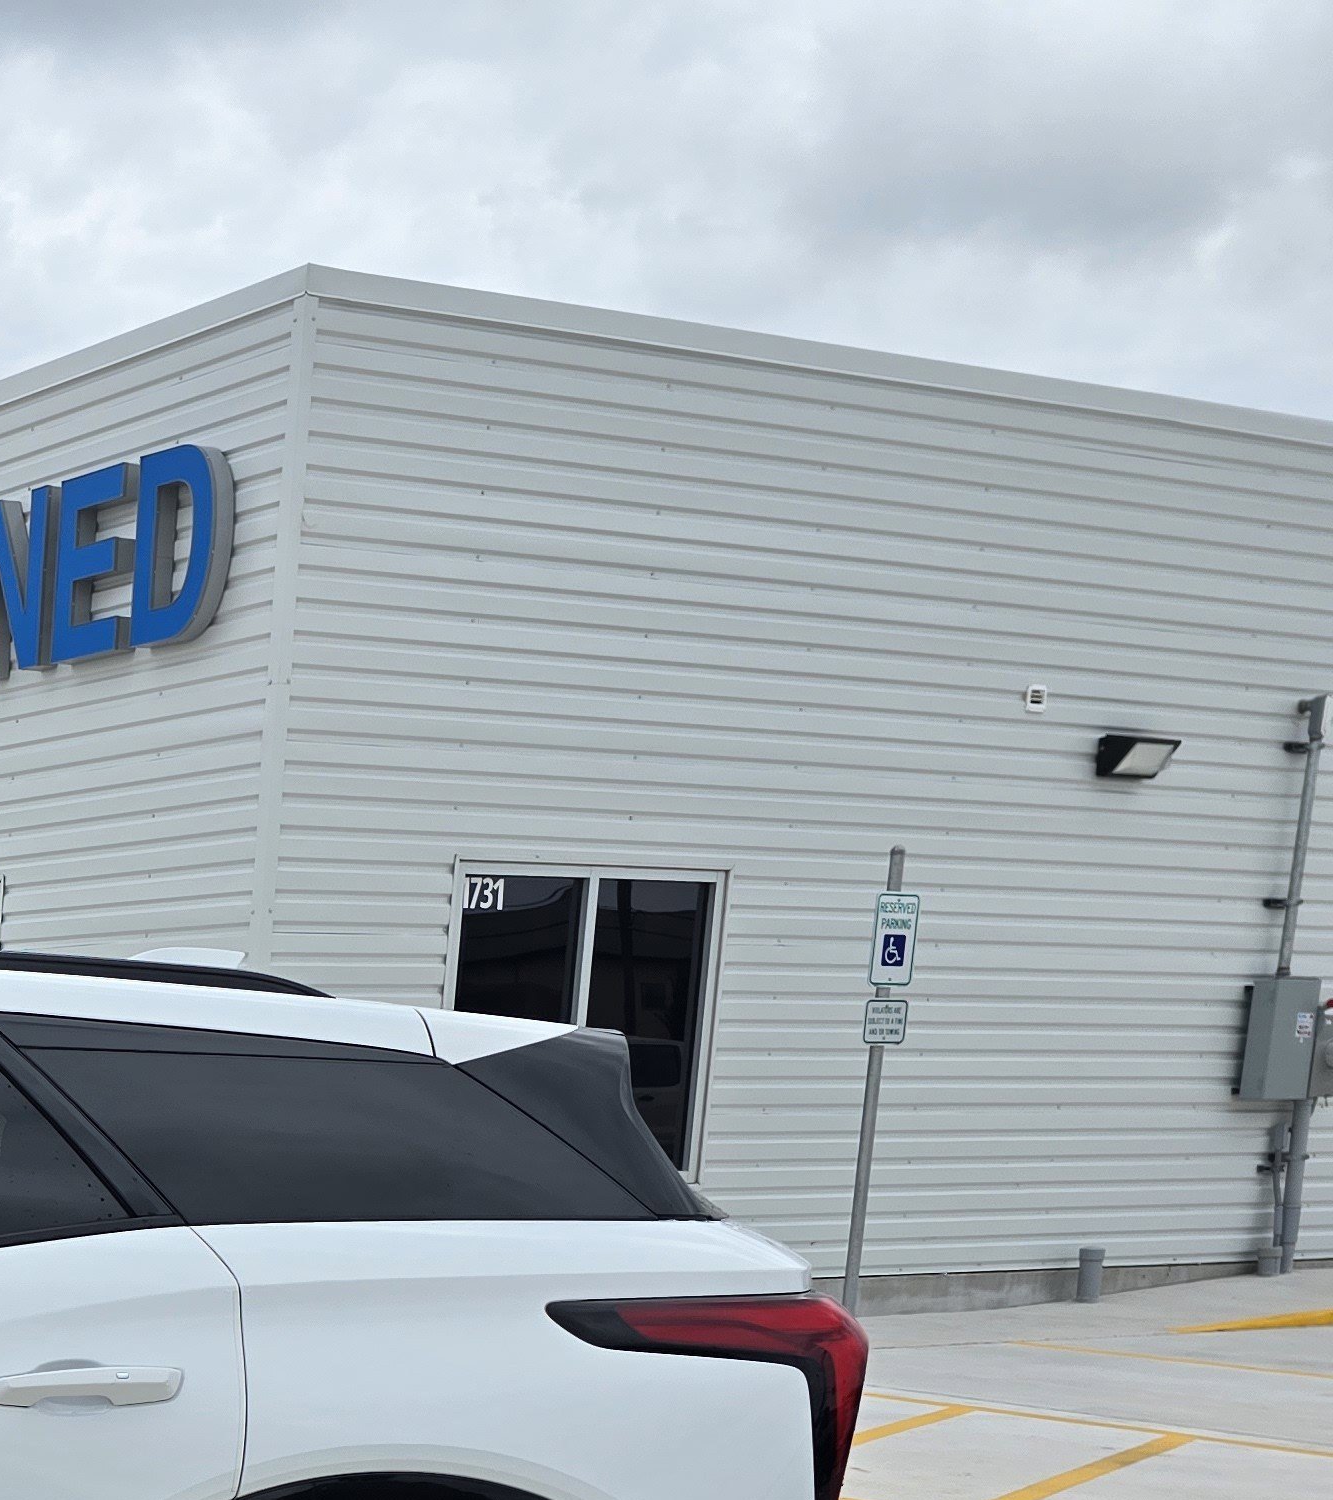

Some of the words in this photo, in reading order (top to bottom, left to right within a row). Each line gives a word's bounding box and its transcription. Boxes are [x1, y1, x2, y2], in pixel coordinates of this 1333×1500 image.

[463, 876, 505, 911] 1731
[880, 902, 917, 915] RESERVED
[880, 917, 912, 930] PARKING
